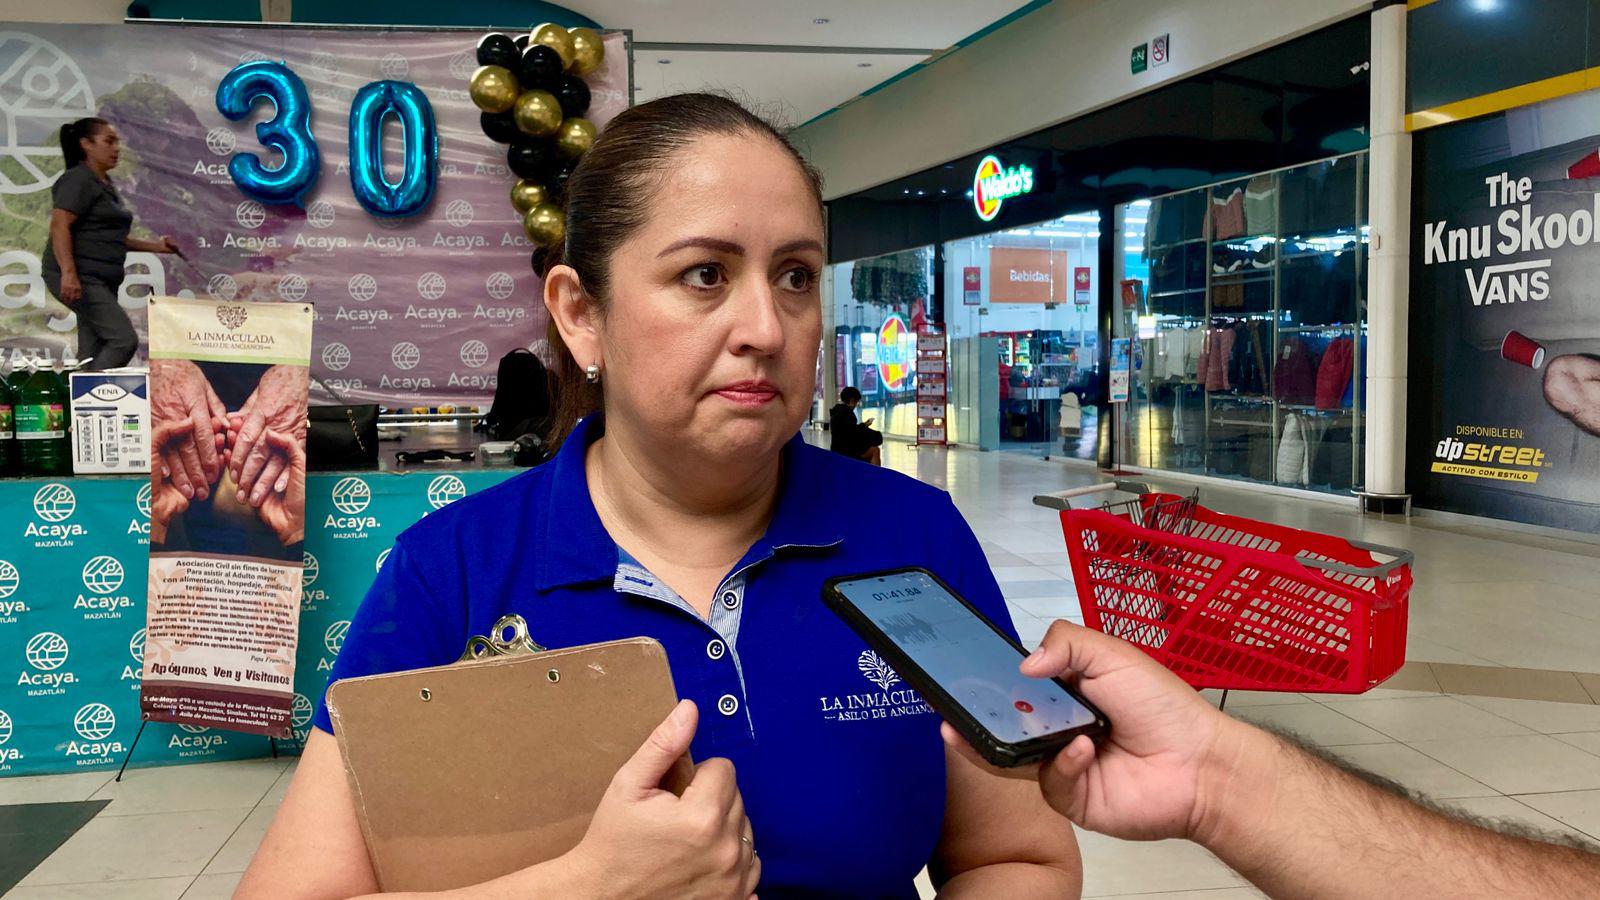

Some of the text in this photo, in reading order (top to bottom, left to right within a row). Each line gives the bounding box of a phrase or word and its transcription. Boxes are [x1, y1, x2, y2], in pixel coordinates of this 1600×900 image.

[192, 160, 231, 179] Aca
[473, 162, 514, 179] Acay
[979, 164, 1033, 201] Waldo's
[1485, 172, 1532, 207] The
[223, 233, 282, 251] Acaya.
[293, 233, 351, 252] Acaya.
[363, 233, 421, 251] Acaya.
[432, 232, 490, 250] Acaya.
[501, 232, 534, 247] Aca
[1424, 220, 1491, 265] Knu
[1010, 269, 1050, 282] Bebidas
[1465, 259, 1552, 306] VANS
[335, 306, 393, 324] Acaya.
[404, 304, 462, 322] Acaya.
[473, 303, 530, 321] Acaya.
[188, 332, 275, 344] LA INMACULADA
[379, 374, 436, 391] Acaya.
[447, 372, 497, 389] Acaya
[1456, 425, 1525, 439] DISPONIBLE EN:
[1441, 465, 1529, 480] ACTITUD CON ESTILO
[24, 521, 88, 540] Acaya.
[324, 514, 381, 532] Acaya.
[176, 560, 214, 568] Asociación
[186, 585, 213, 593] terapias
[242, 590, 277, 598] recreativas
[228, 580, 262, 589] hospedaje,
[74, 594, 135, 611] Acaya.
[302, 589, 330, 604] ya.
[872, 586, 922, 602] 01:41.84
[0, 600, 31, 616] aya.
[17, 671, 79, 687] Acaya.
[213, 666, 233, 678] Ven
[235, 670, 241, 682] y
[820, 689, 923, 711] LA INMACUL
[838, 708, 869, 721] ASILO
[872, 708, 887, 719] DE
[66, 741, 127, 757] Acaya.
[168, 734, 228, 749] Acaya.
